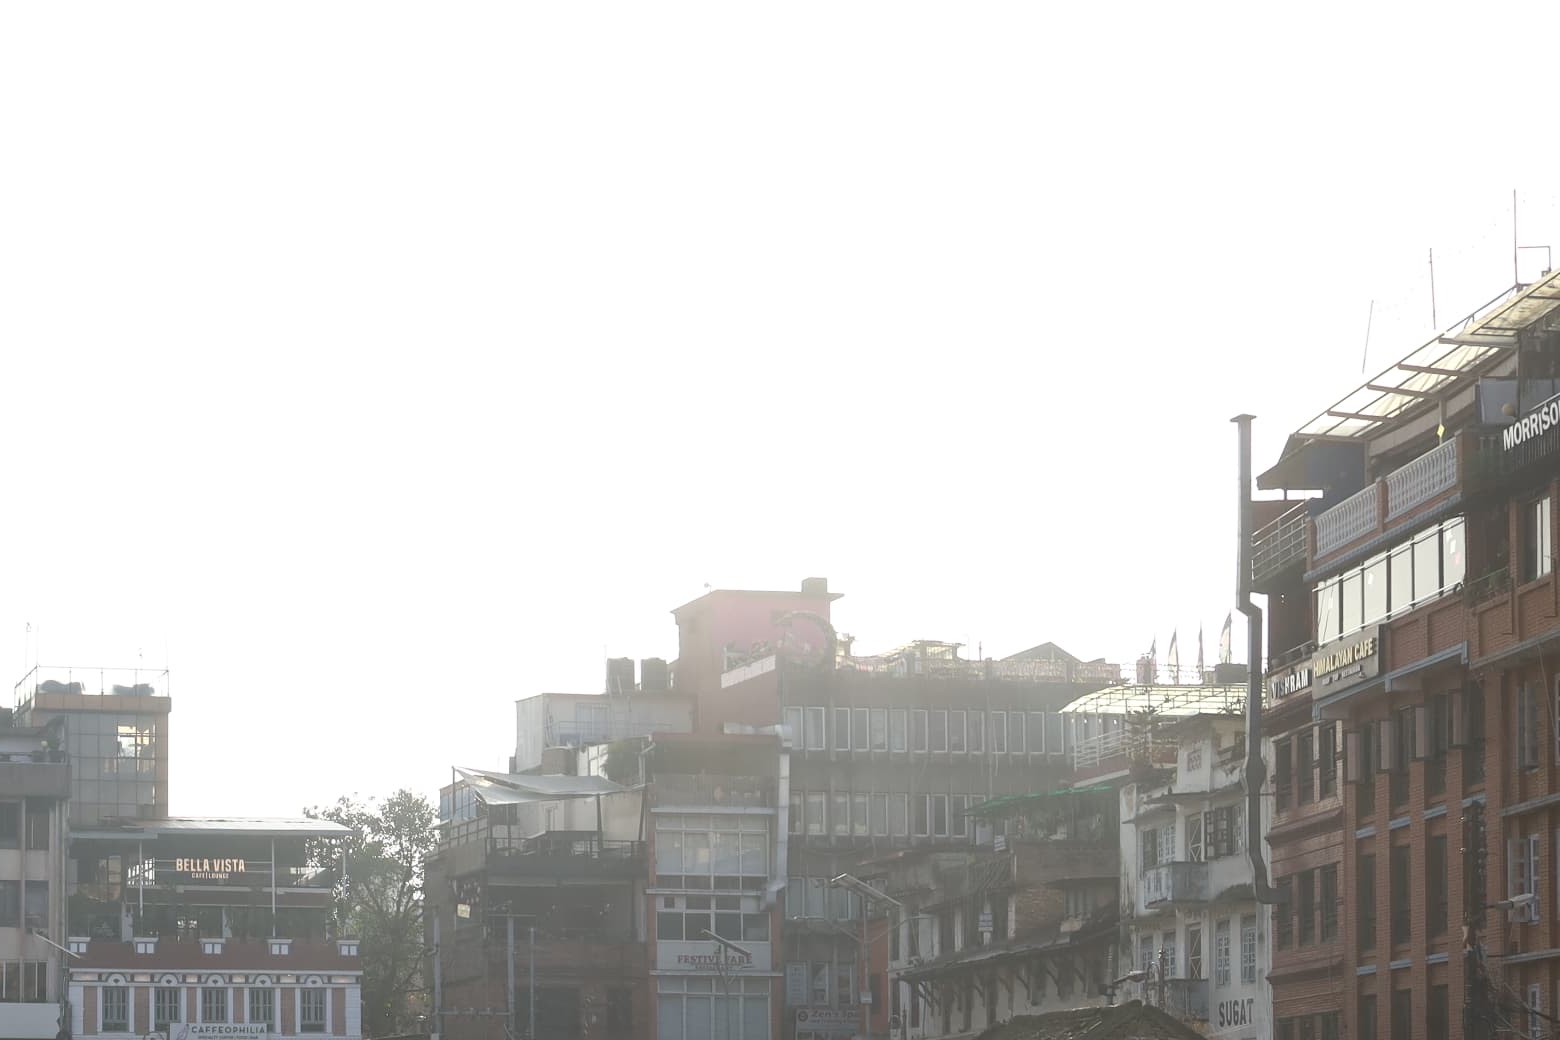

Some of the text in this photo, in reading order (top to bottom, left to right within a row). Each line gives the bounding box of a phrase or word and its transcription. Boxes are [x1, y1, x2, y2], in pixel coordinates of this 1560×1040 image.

[1313, 647, 1353, 678] HIMALAYAN
[1354, 637, 1373, 661] CAFE
[1272, 668, 1309, 700] VISHRAM
[176, 858, 246, 873] BELLA VISTA
[1219, 998, 1254, 1028] SUGAT
[191, 1025, 265, 1034] CAFFEOPHILIA
